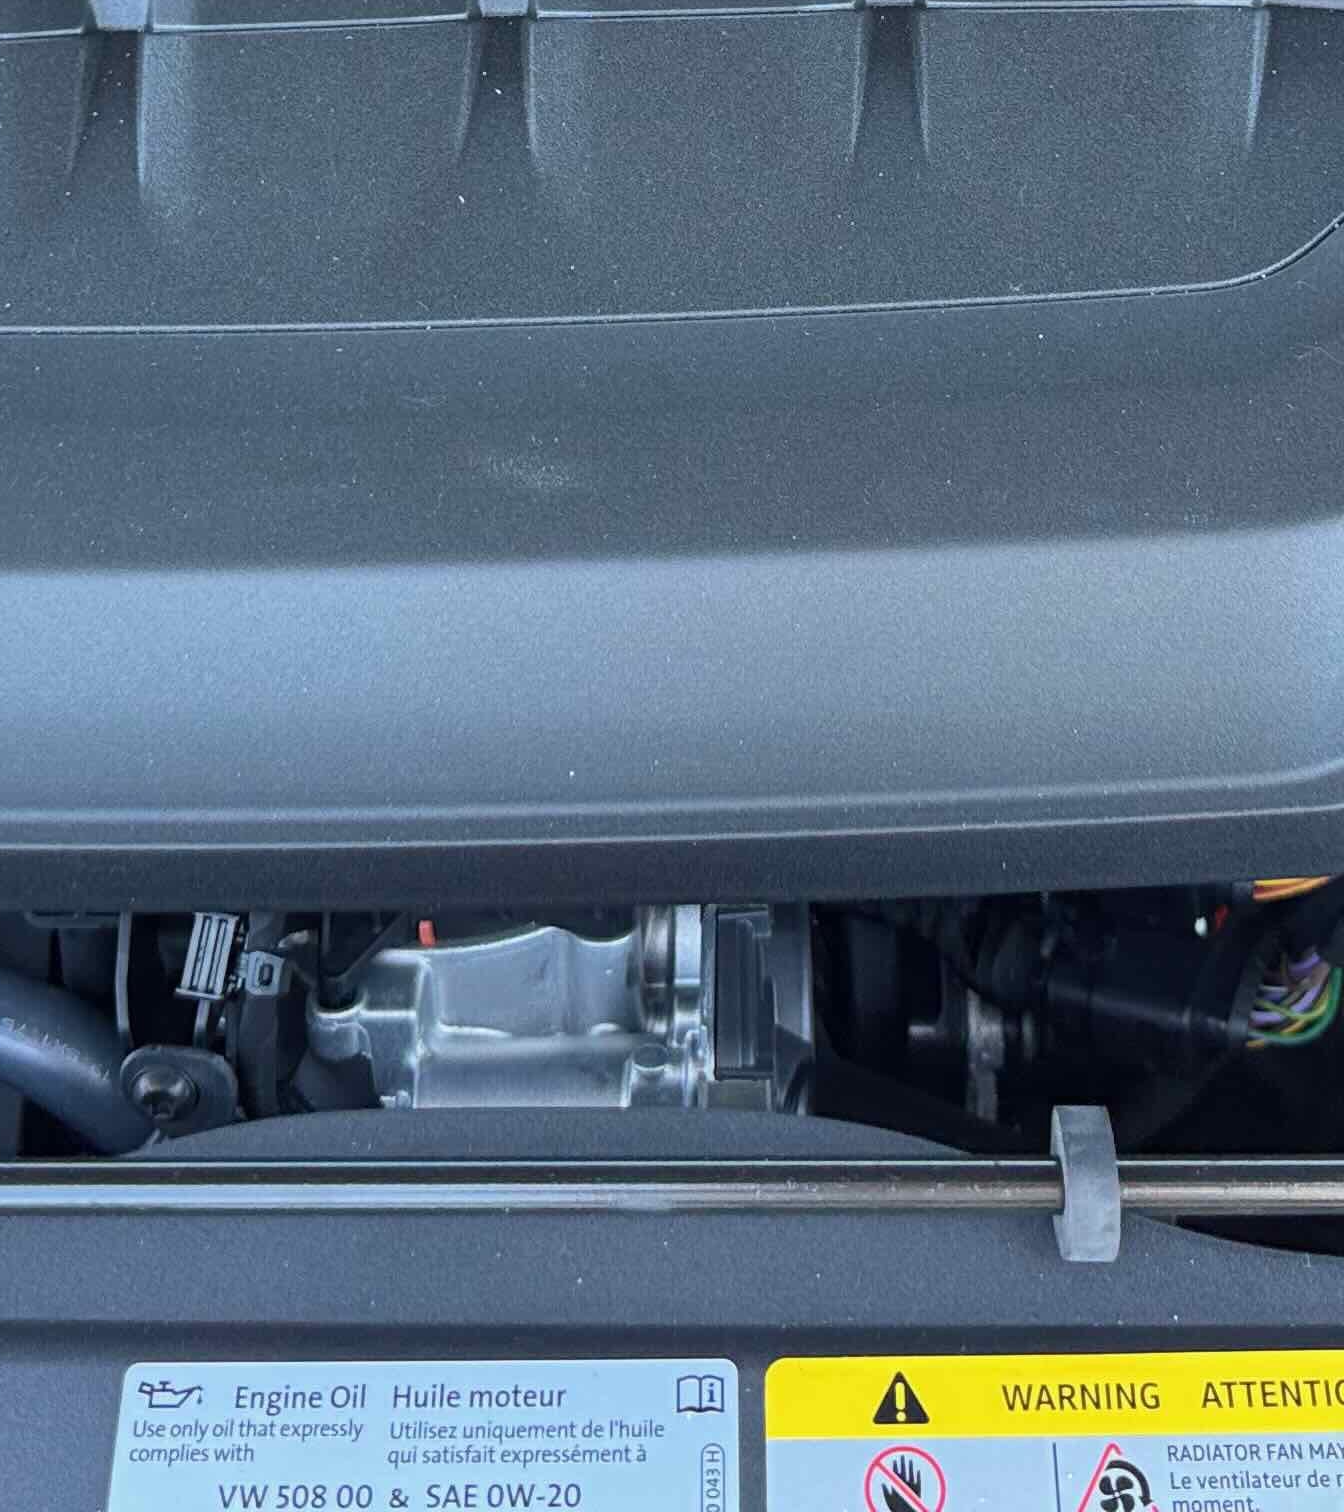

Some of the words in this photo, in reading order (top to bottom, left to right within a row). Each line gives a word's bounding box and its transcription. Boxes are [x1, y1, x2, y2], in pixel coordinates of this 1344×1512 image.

[234, 1385, 324, 1416] Engine
[330, 1384, 367, 1409] Oil
[393, 1384, 462, 1408] Huile
[468, 1387, 567, 1408] moteur
[1002, 1382, 1161, 1411] WARNING
[132, 1420, 167, 1439] Use
[170, 1419, 209, 1446] only
[212, 1419, 235, 1438] oil
[238, 1420, 276, 1438] that
[279, 1419, 365, 1442] expressly
[389, 1421, 458, 1440] Utilisez
[462, 1421, 578, 1444] uniquement
[581, 1420, 605, 1439] de
[608, 1419, 666, 1439] l'huile
[129, 1444, 209, 1467] complies
[213, 1443, 256, 1463] with
[387, 1446, 418, 1468] qui
[422, 1444, 497, 1465] satisfait
[499, 1444, 632, 1468] expressément
[635, 1442, 648, 1464] à
[1167, 1443, 1261, 1463] RADIATOR
[1267, 1443, 1305, 1461] FAN
[1170, 1470, 1192, 1490] Le
[1197, 1470, 1302, 1490] ventilateur
[1307, 1470, 1331, 1488] de
[218, 1484, 269, 1509] VW
[275, 1484, 328, 1509] 508
[336, 1484, 374, 1509] 00
[388, 1489, 409, 1509] &
[425, 1484, 479, 1509] SAE
[487, 1483, 582, 1509] 0W-20
[1172, 1496, 1260, 1512] moment.
